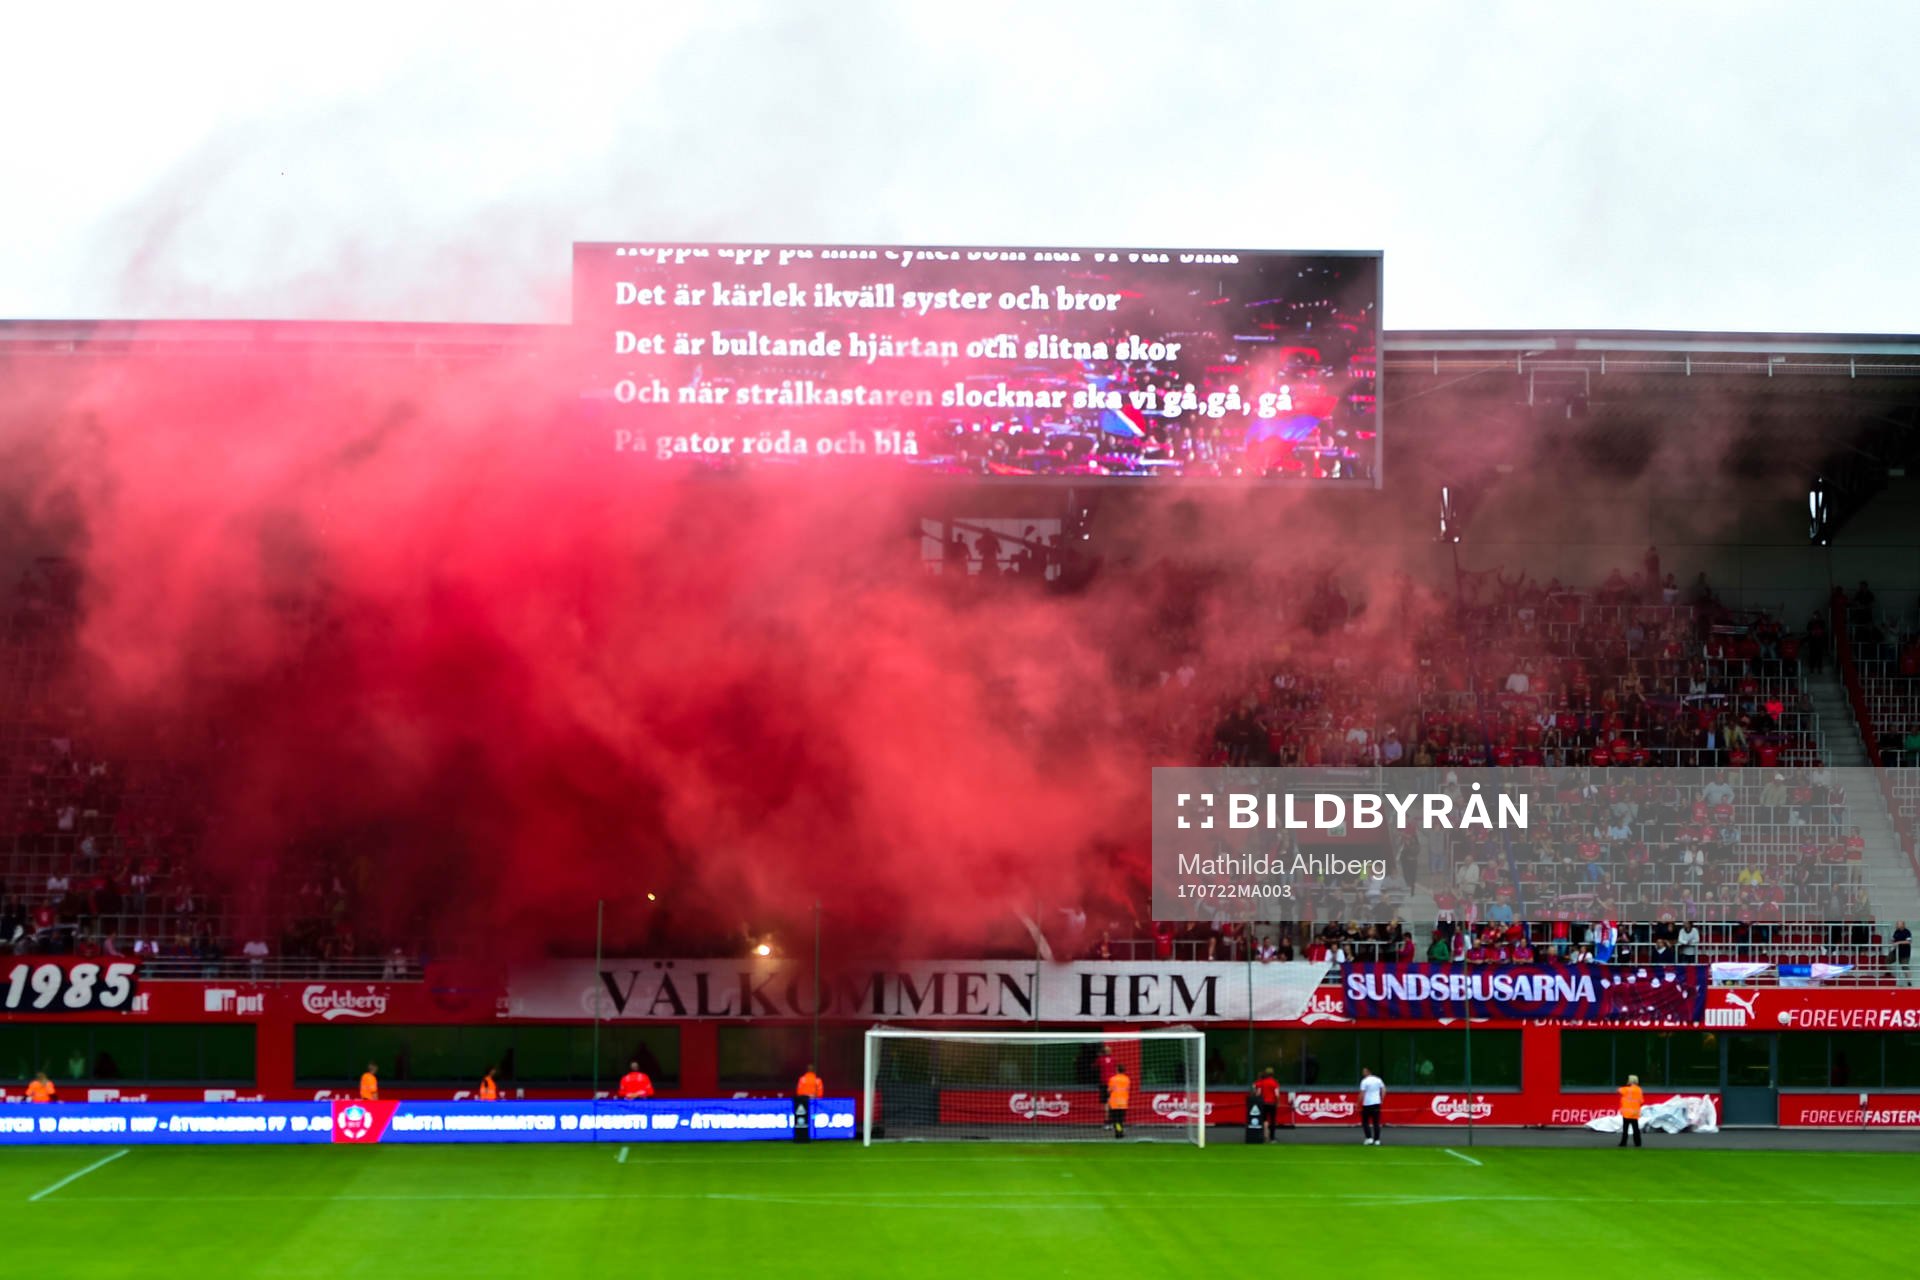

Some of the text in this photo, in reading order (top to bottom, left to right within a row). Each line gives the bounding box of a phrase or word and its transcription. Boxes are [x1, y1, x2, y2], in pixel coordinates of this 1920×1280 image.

[616, 281, 1121, 315] Det är kärlek ikväll syster och bror
[615, 331, 1181, 364] Det är bultande hjärtan och slitna skor
[614, 379, 670, 403] Och
[677, 381, 729, 404] när
[736, 380, 933, 406] strålkastaren
[941, 383, 1067, 409] slocknar
[1073, 384, 1123, 409] ska
[1129, 384, 1157, 409] vi
[1259, 385, 1293, 417] gå
[614, 428, 919, 460] På gator röda och blå
[5, 963, 136, 1009] 1985
[302, 985, 387, 1014] Carlsberg
[599, 961, 1223, 1018] VÄLKOMMEN HEM
[1347, 973, 1597, 1003] SUNDSBUSARNA
[1704, 1008, 1746, 1027] UMA
[1009, 1094, 1070, 1114] Carlsberg
[1295, 1094, 1354, 1115] Carlsberg
[1431, 1095, 1492, 1116] Carlsberg
